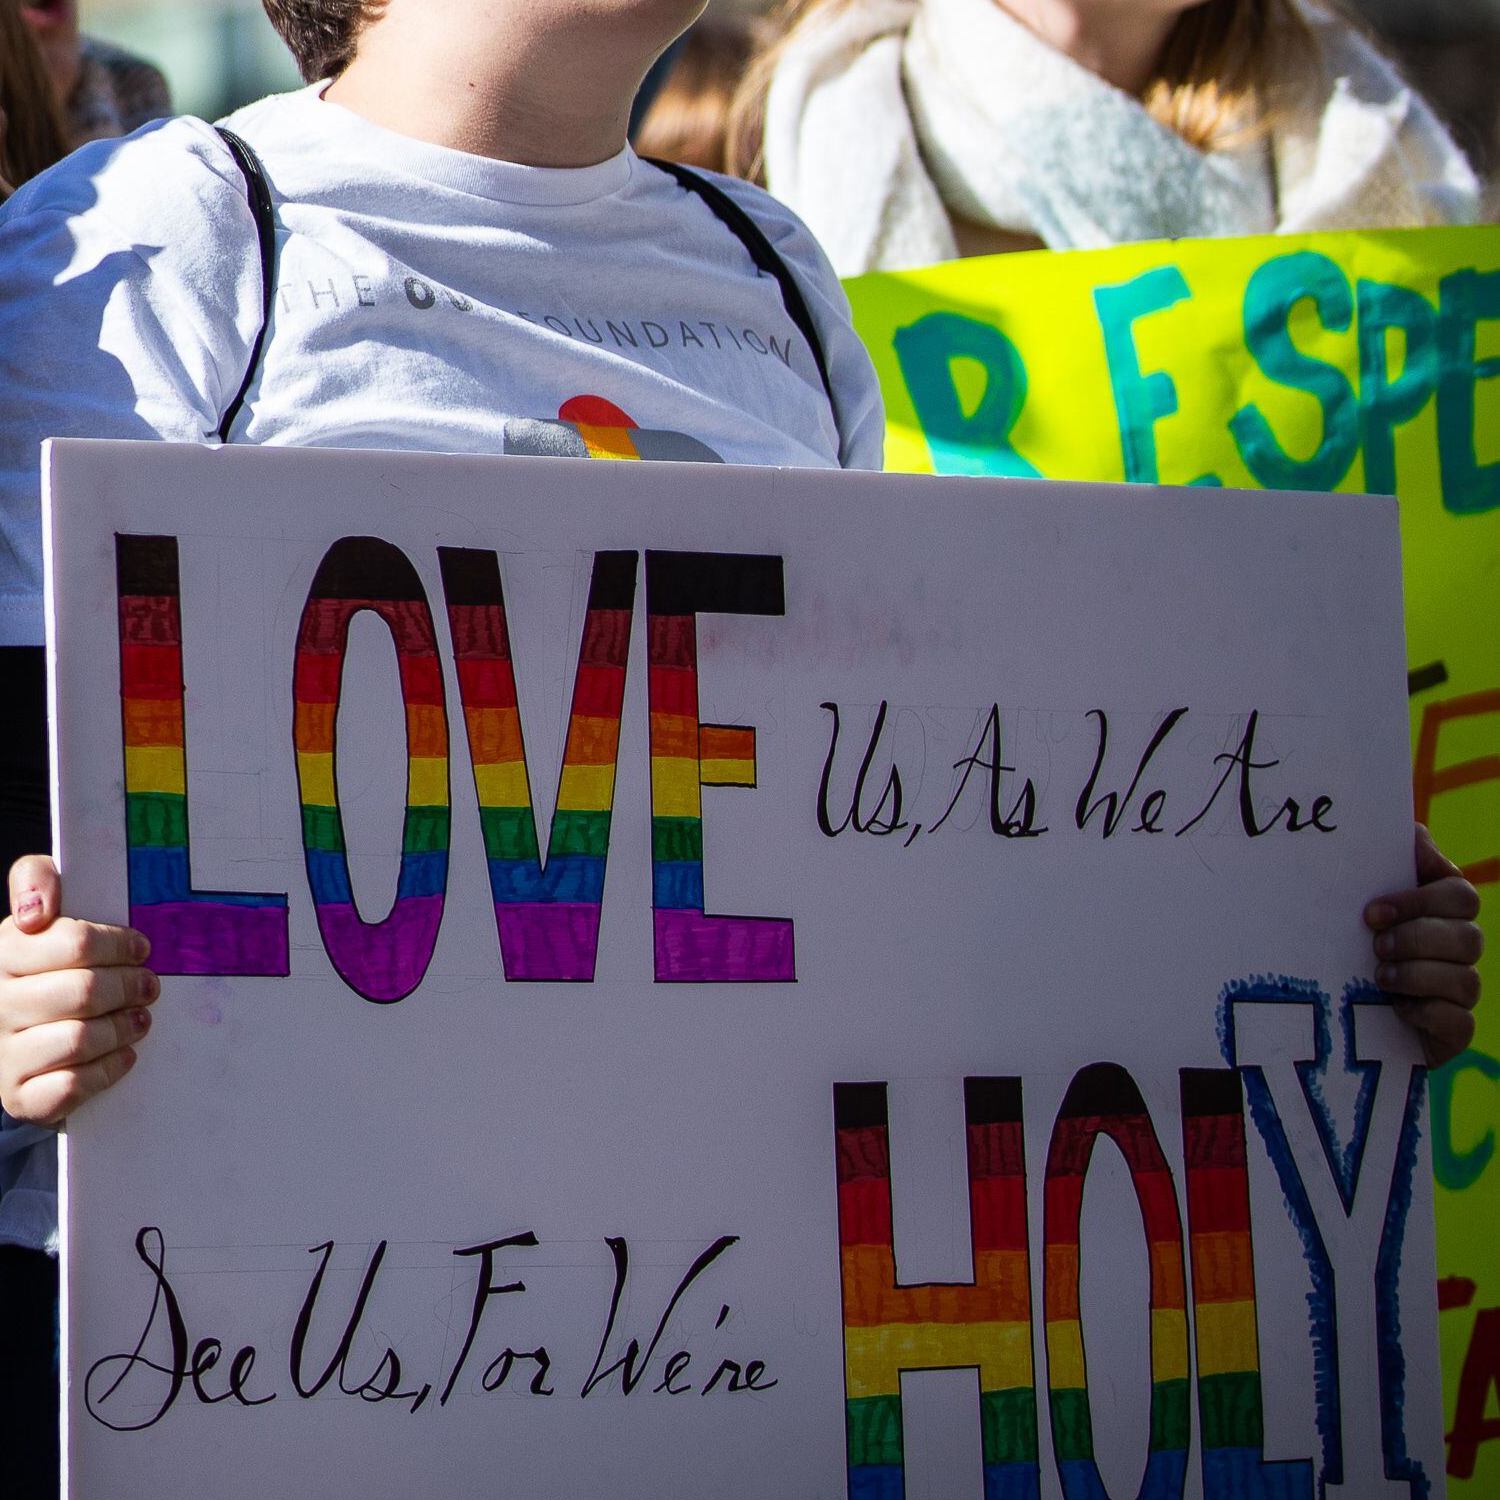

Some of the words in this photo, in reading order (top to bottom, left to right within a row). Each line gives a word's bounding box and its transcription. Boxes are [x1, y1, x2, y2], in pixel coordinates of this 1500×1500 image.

[276, 275, 376, 315] THE
[404, 276, 476, 312] OU
[114, 532, 797, 1004] LOVE
[816, 700, 921, 848] Us,
[929, 702, 1048, 838] As
[1075, 706, 1189, 839] We
[1175, 709, 1337, 838] Are
[84, 1226, 277, 1432] See
[290, 1240, 432, 1414] Us,
[441, 1230, 555, 1406] For
[582, 1235, 778, 1400] We're
[832, 974, 1432, 1500] HOLY
